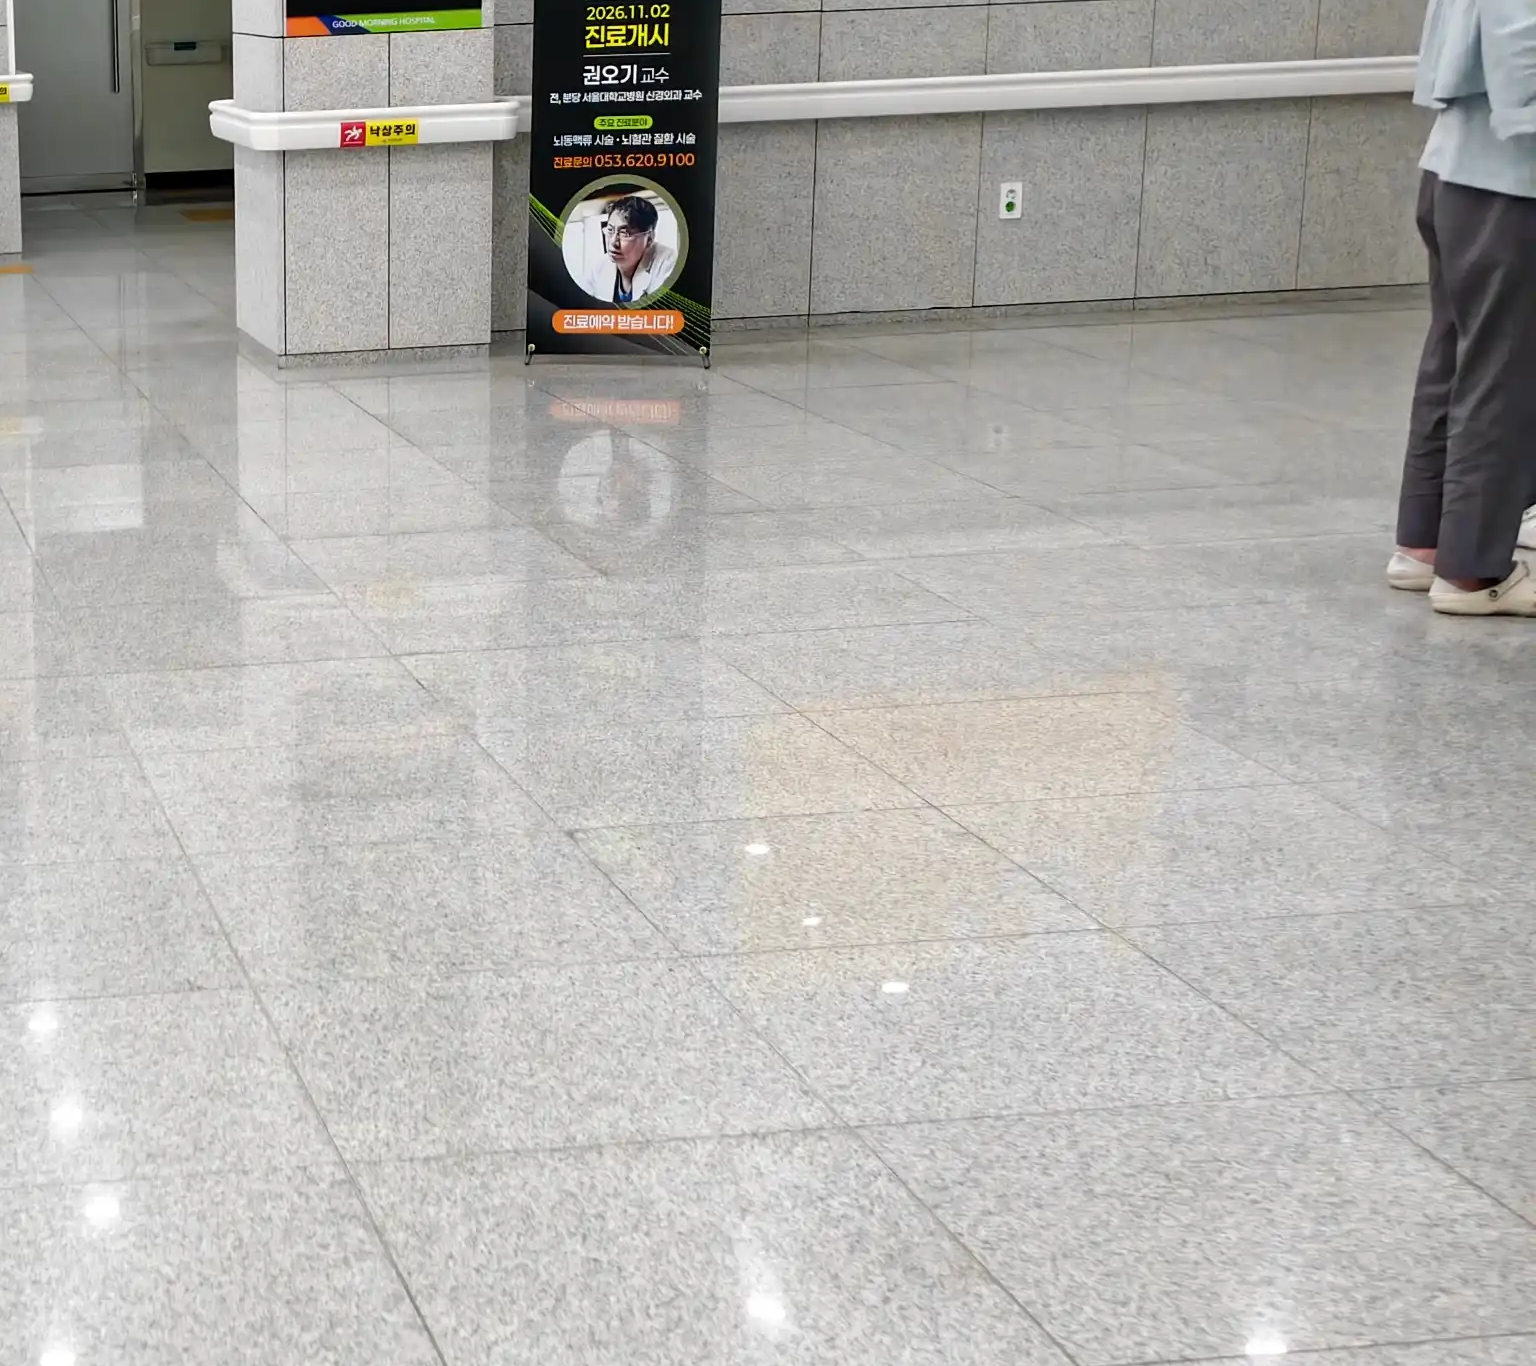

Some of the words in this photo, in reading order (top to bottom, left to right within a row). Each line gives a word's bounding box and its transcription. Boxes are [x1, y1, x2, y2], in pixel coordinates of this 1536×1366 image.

[586, 4, 670, 21] 2026.11.02
[332, 19, 359, 28] GOOD
[360, 19, 397, 27] MORNING
[399, 17, 435, 25] HOSPITAL
[585, 23, 669, 48] 진료개시
[582, 65, 637, 85] 권오기
[640, 67, 670, 84] 교수
[563, 93, 581, 104] 분당
[582, 91, 644, 103] 서울대학교병원
[646, 90, 682, 101] 신경외과
[684, 89, 703, 100] 교수
[370, 123, 416, 137] 낙상주의
[553, 135, 593, 147] 뇌동맥류
[594, 134, 614, 146] 시술
[621, 133, 652, 146] 뇌혈관
[653, 133, 674, 145] 질환
[676, 132, 696, 145] 시술
[553, 155, 592, 168] 진료문의
[594, 153, 695, 168] 053.620.9100
[564, 314, 615, 330] 진료예약
[618, 314, 674, 330] 받습니다!
